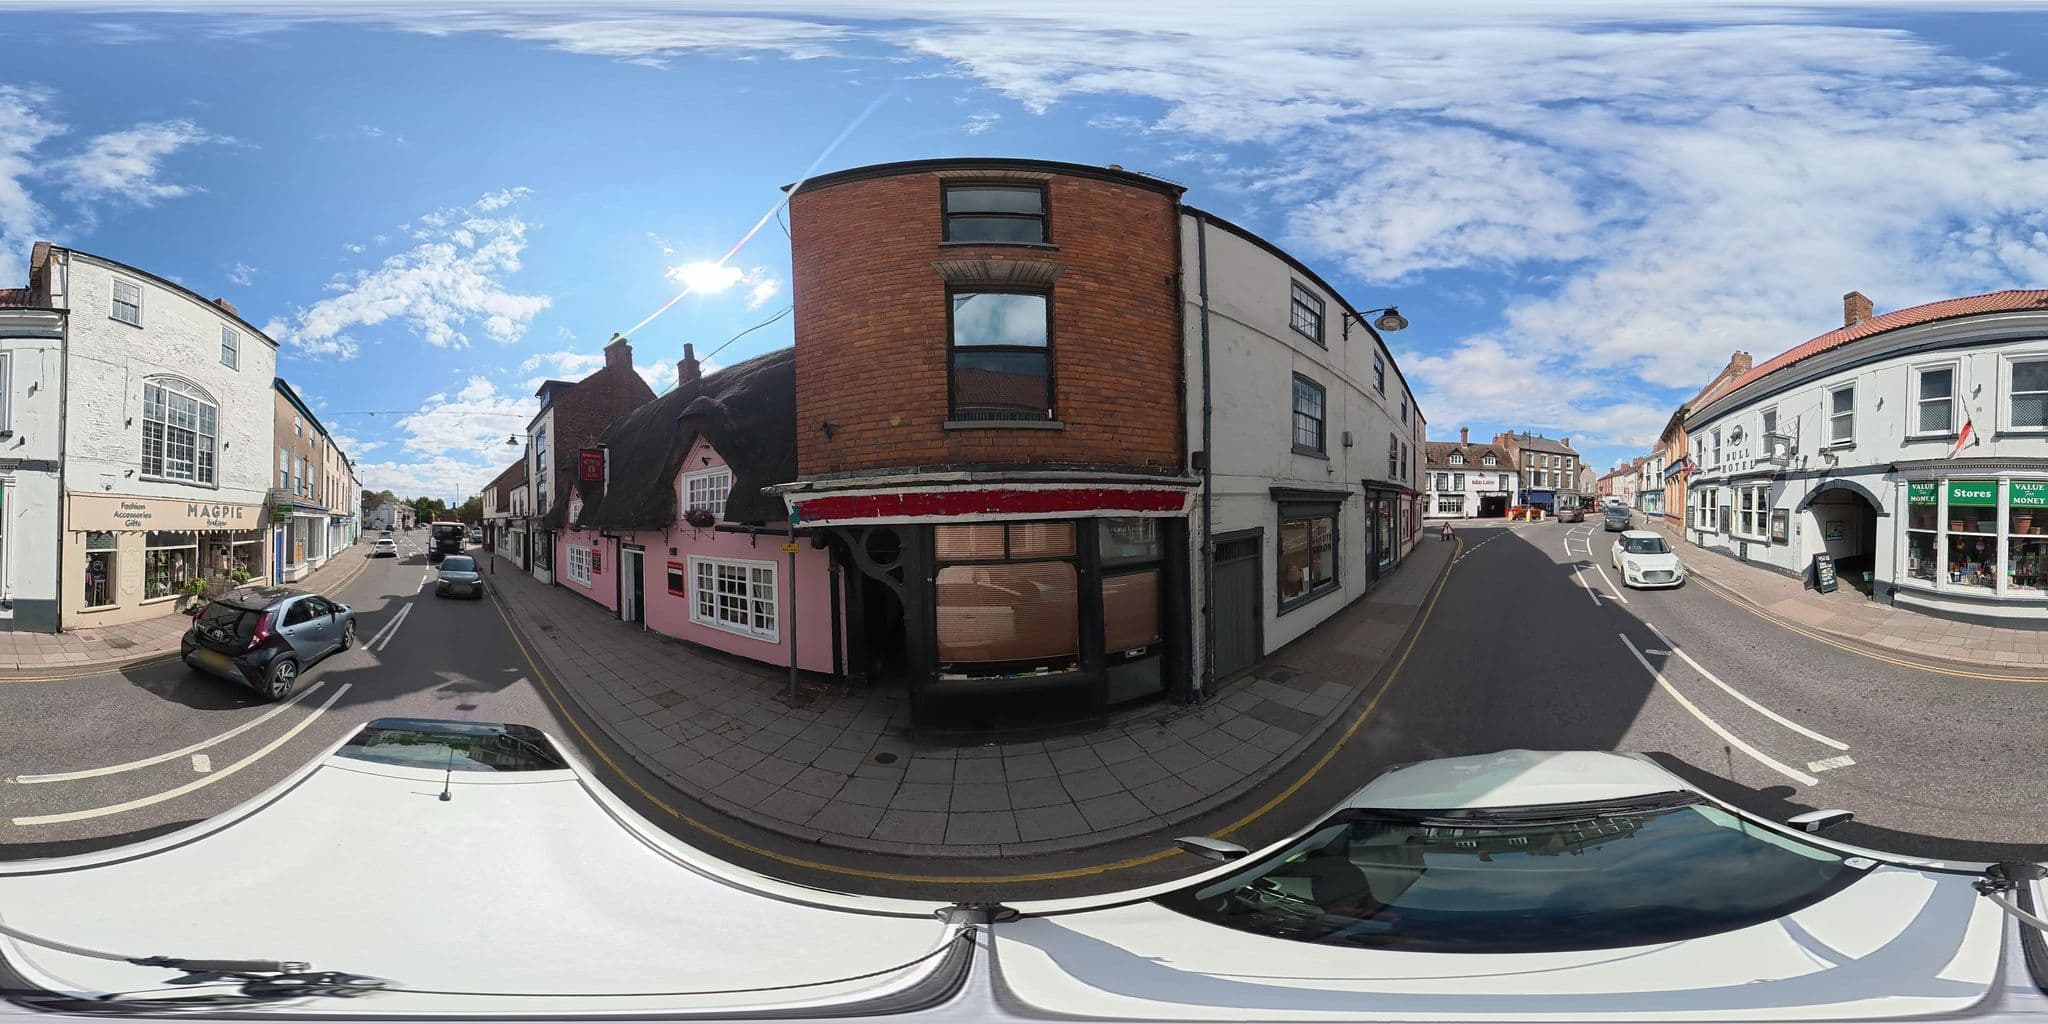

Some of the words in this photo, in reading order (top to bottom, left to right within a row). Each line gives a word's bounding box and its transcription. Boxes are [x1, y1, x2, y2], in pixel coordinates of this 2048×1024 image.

[1726, 448, 1750, 462] BULL
[1722, 460, 1755, 473] HOTEL
[1954, 489, 1992, 498] Stores
[121, 502, 146, 510] Fashion
[113, 510, 152, 519] Accessories
[187, 504, 243, 519] MAGPIE
[125, 519, 142, 527] Gifts
